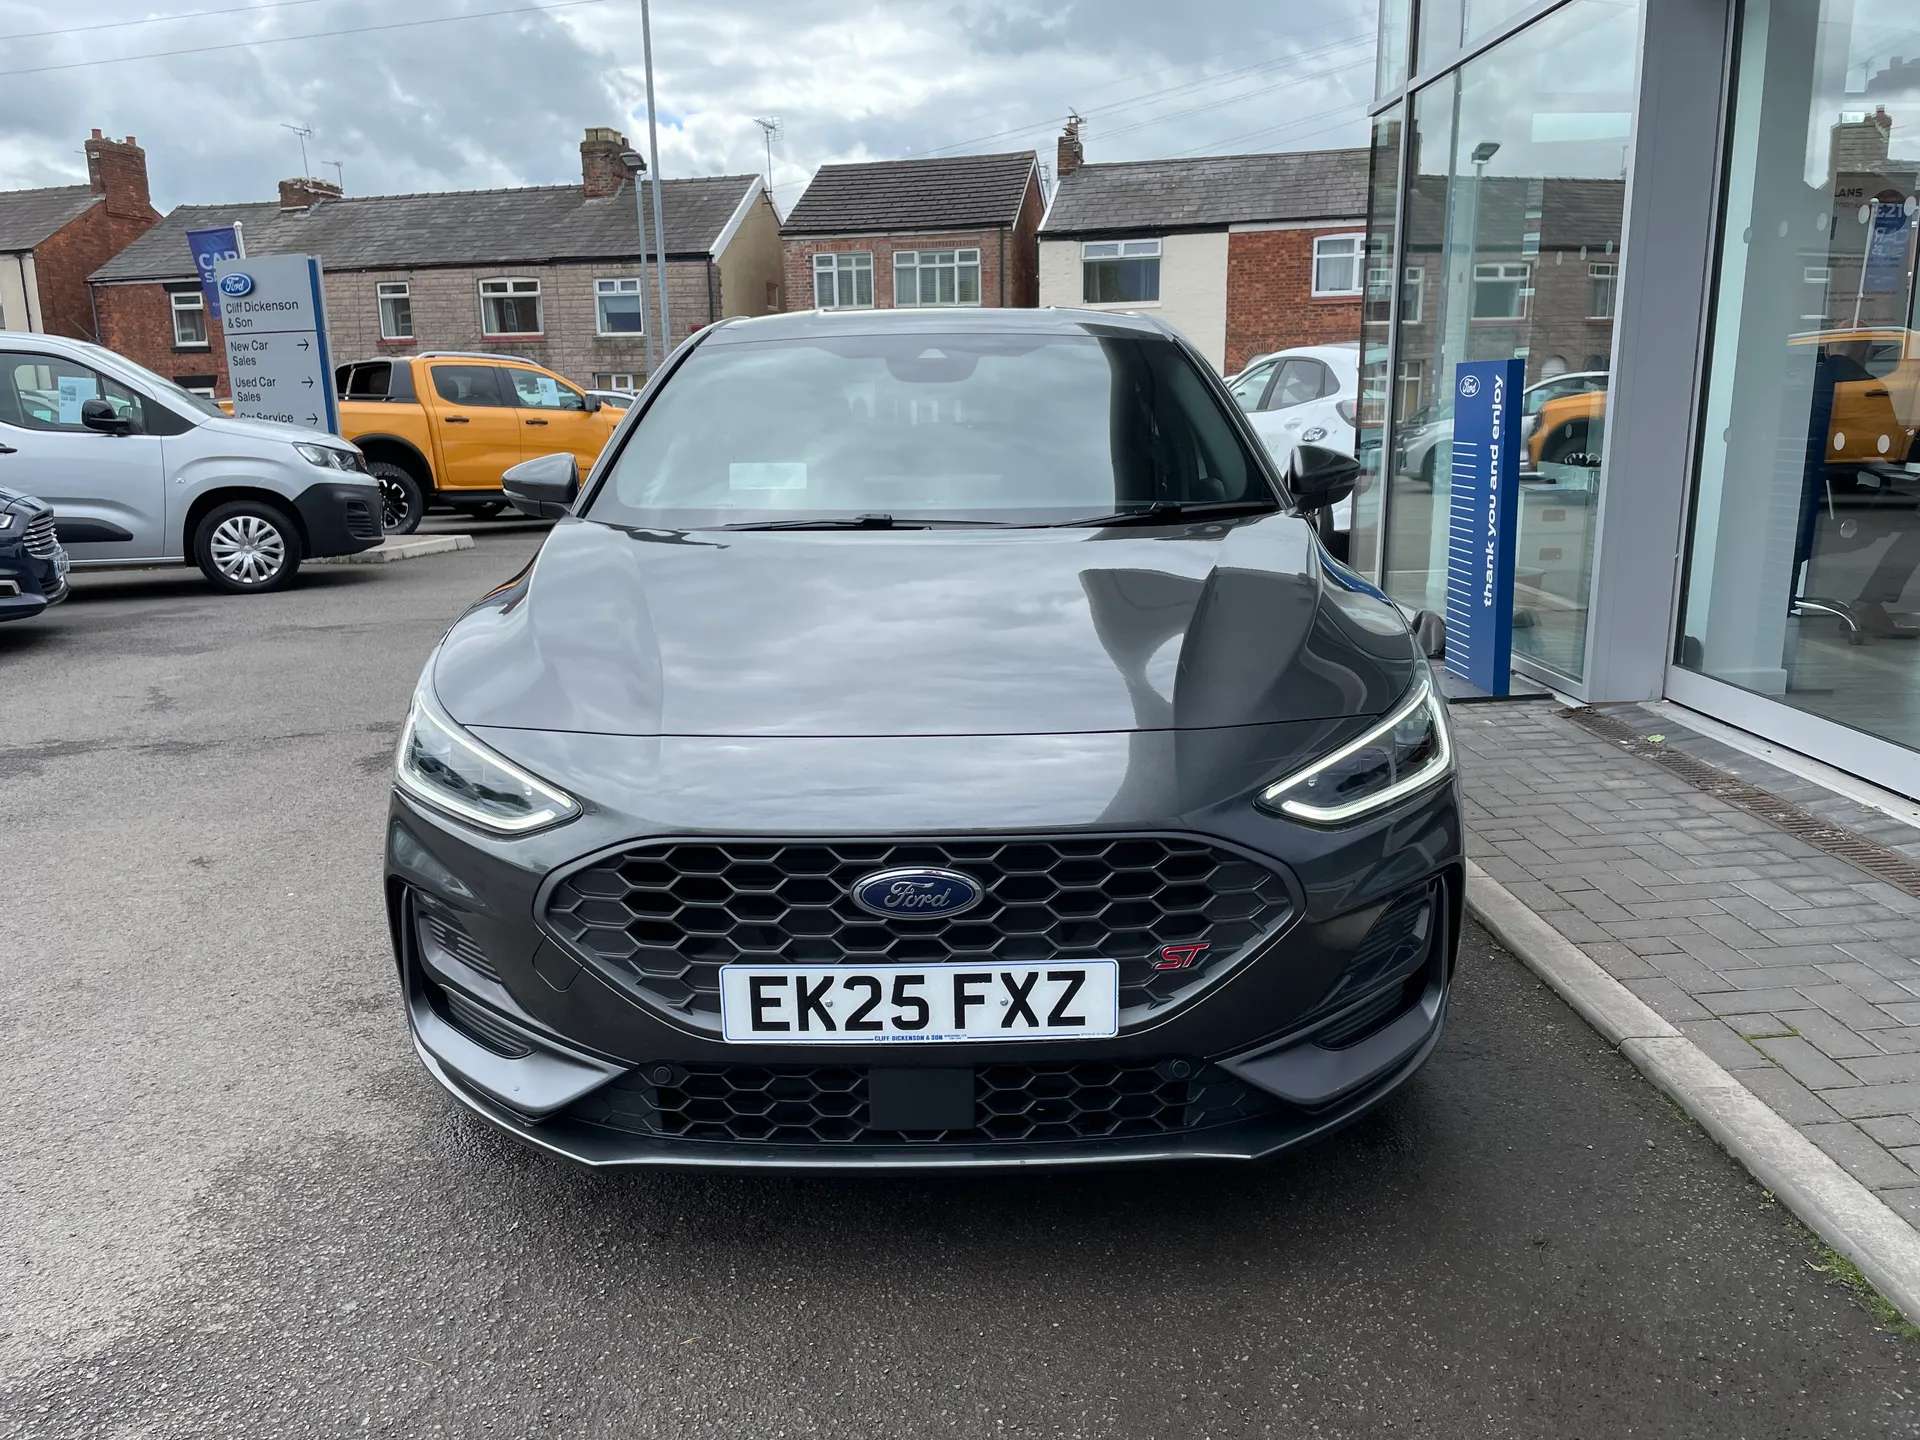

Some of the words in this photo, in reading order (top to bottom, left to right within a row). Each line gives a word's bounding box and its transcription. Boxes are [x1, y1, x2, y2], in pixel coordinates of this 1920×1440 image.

[225, 302, 243, 314] Cliff
[244, 300, 299, 313] Dickenson
[228, 318, 234, 329] &
[235, 317, 253, 328] Son
[230, 341, 250, 352] New
[251, 340, 269, 351] Car
[232, 355, 257, 367] Sales
[235, 376, 257, 388] Used
[258, 376, 276, 388] Car
[237, 391, 262, 402] Sales
[256, 411, 294, 423] Service
[1491, 374, 1504, 440] enjoy
[1489, 444, 1499, 490] and
[1487, 494, 1498, 537] you
[1483, 540, 1495, 608] thank
[883, 880, 952, 908] Ford
[1154, 943, 1210, 969] ST
[749, 974, 930, 1032] EK25
[953, 970, 1086, 1030] FXZ
